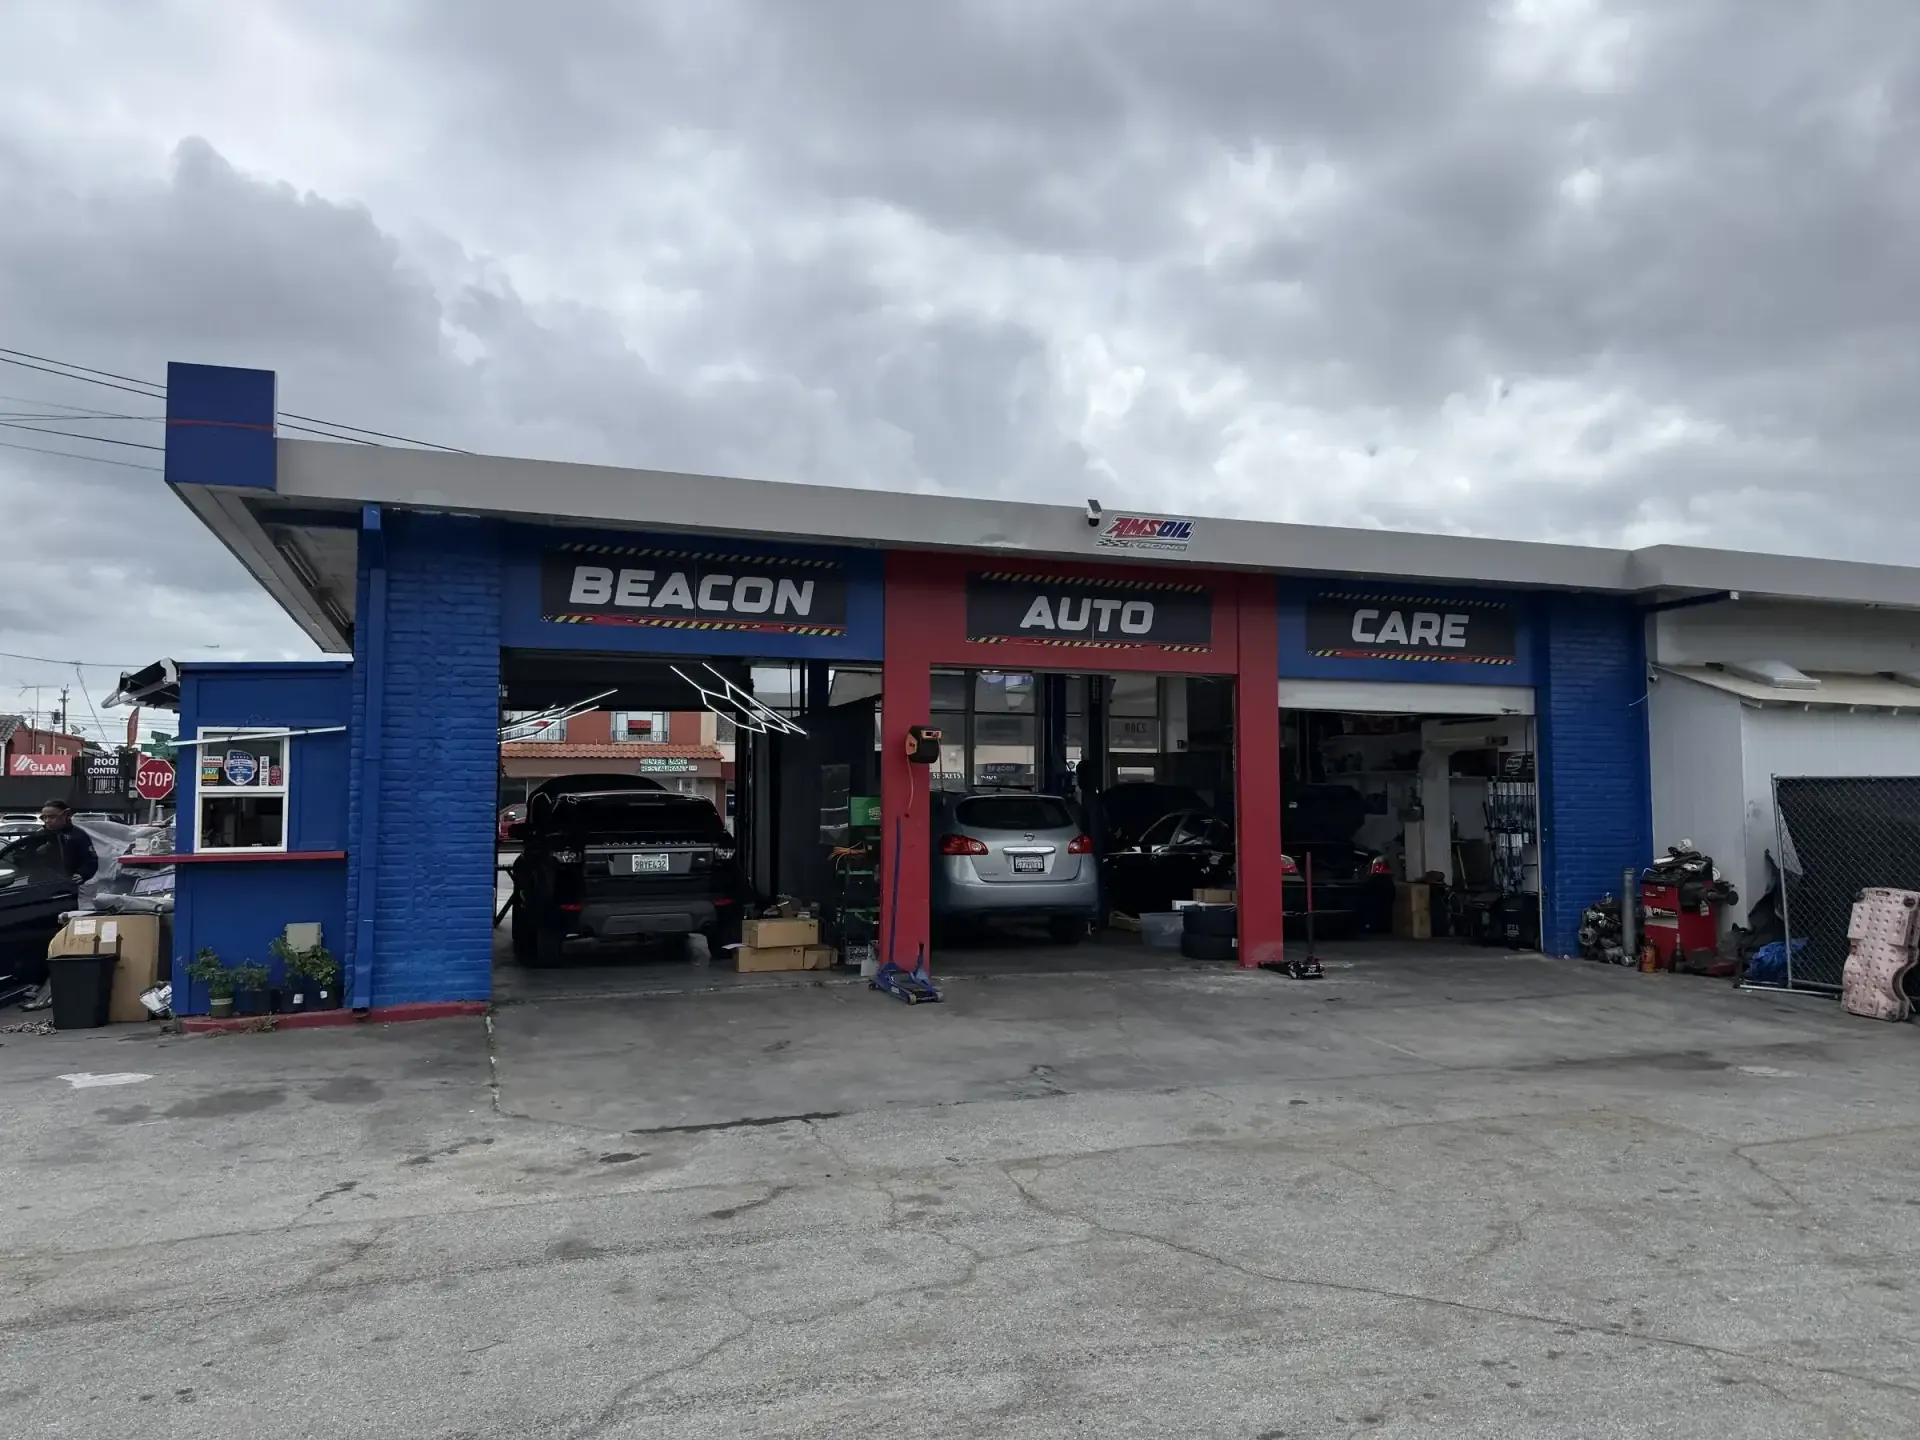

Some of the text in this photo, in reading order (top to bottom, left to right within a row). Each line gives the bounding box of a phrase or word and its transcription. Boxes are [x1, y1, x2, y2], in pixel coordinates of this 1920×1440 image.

[1105, 517, 1193, 539] AMSOIL
[1130, 541, 1188, 552] RACING
[569, 565, 815, 616] BEACON
[1019, 595, 1155, 634] AUTO
[1351, 608, 1470, 648] CARE
[29, 763, 66, 772] GLAM
[138, 772, 173, 787] STOP
